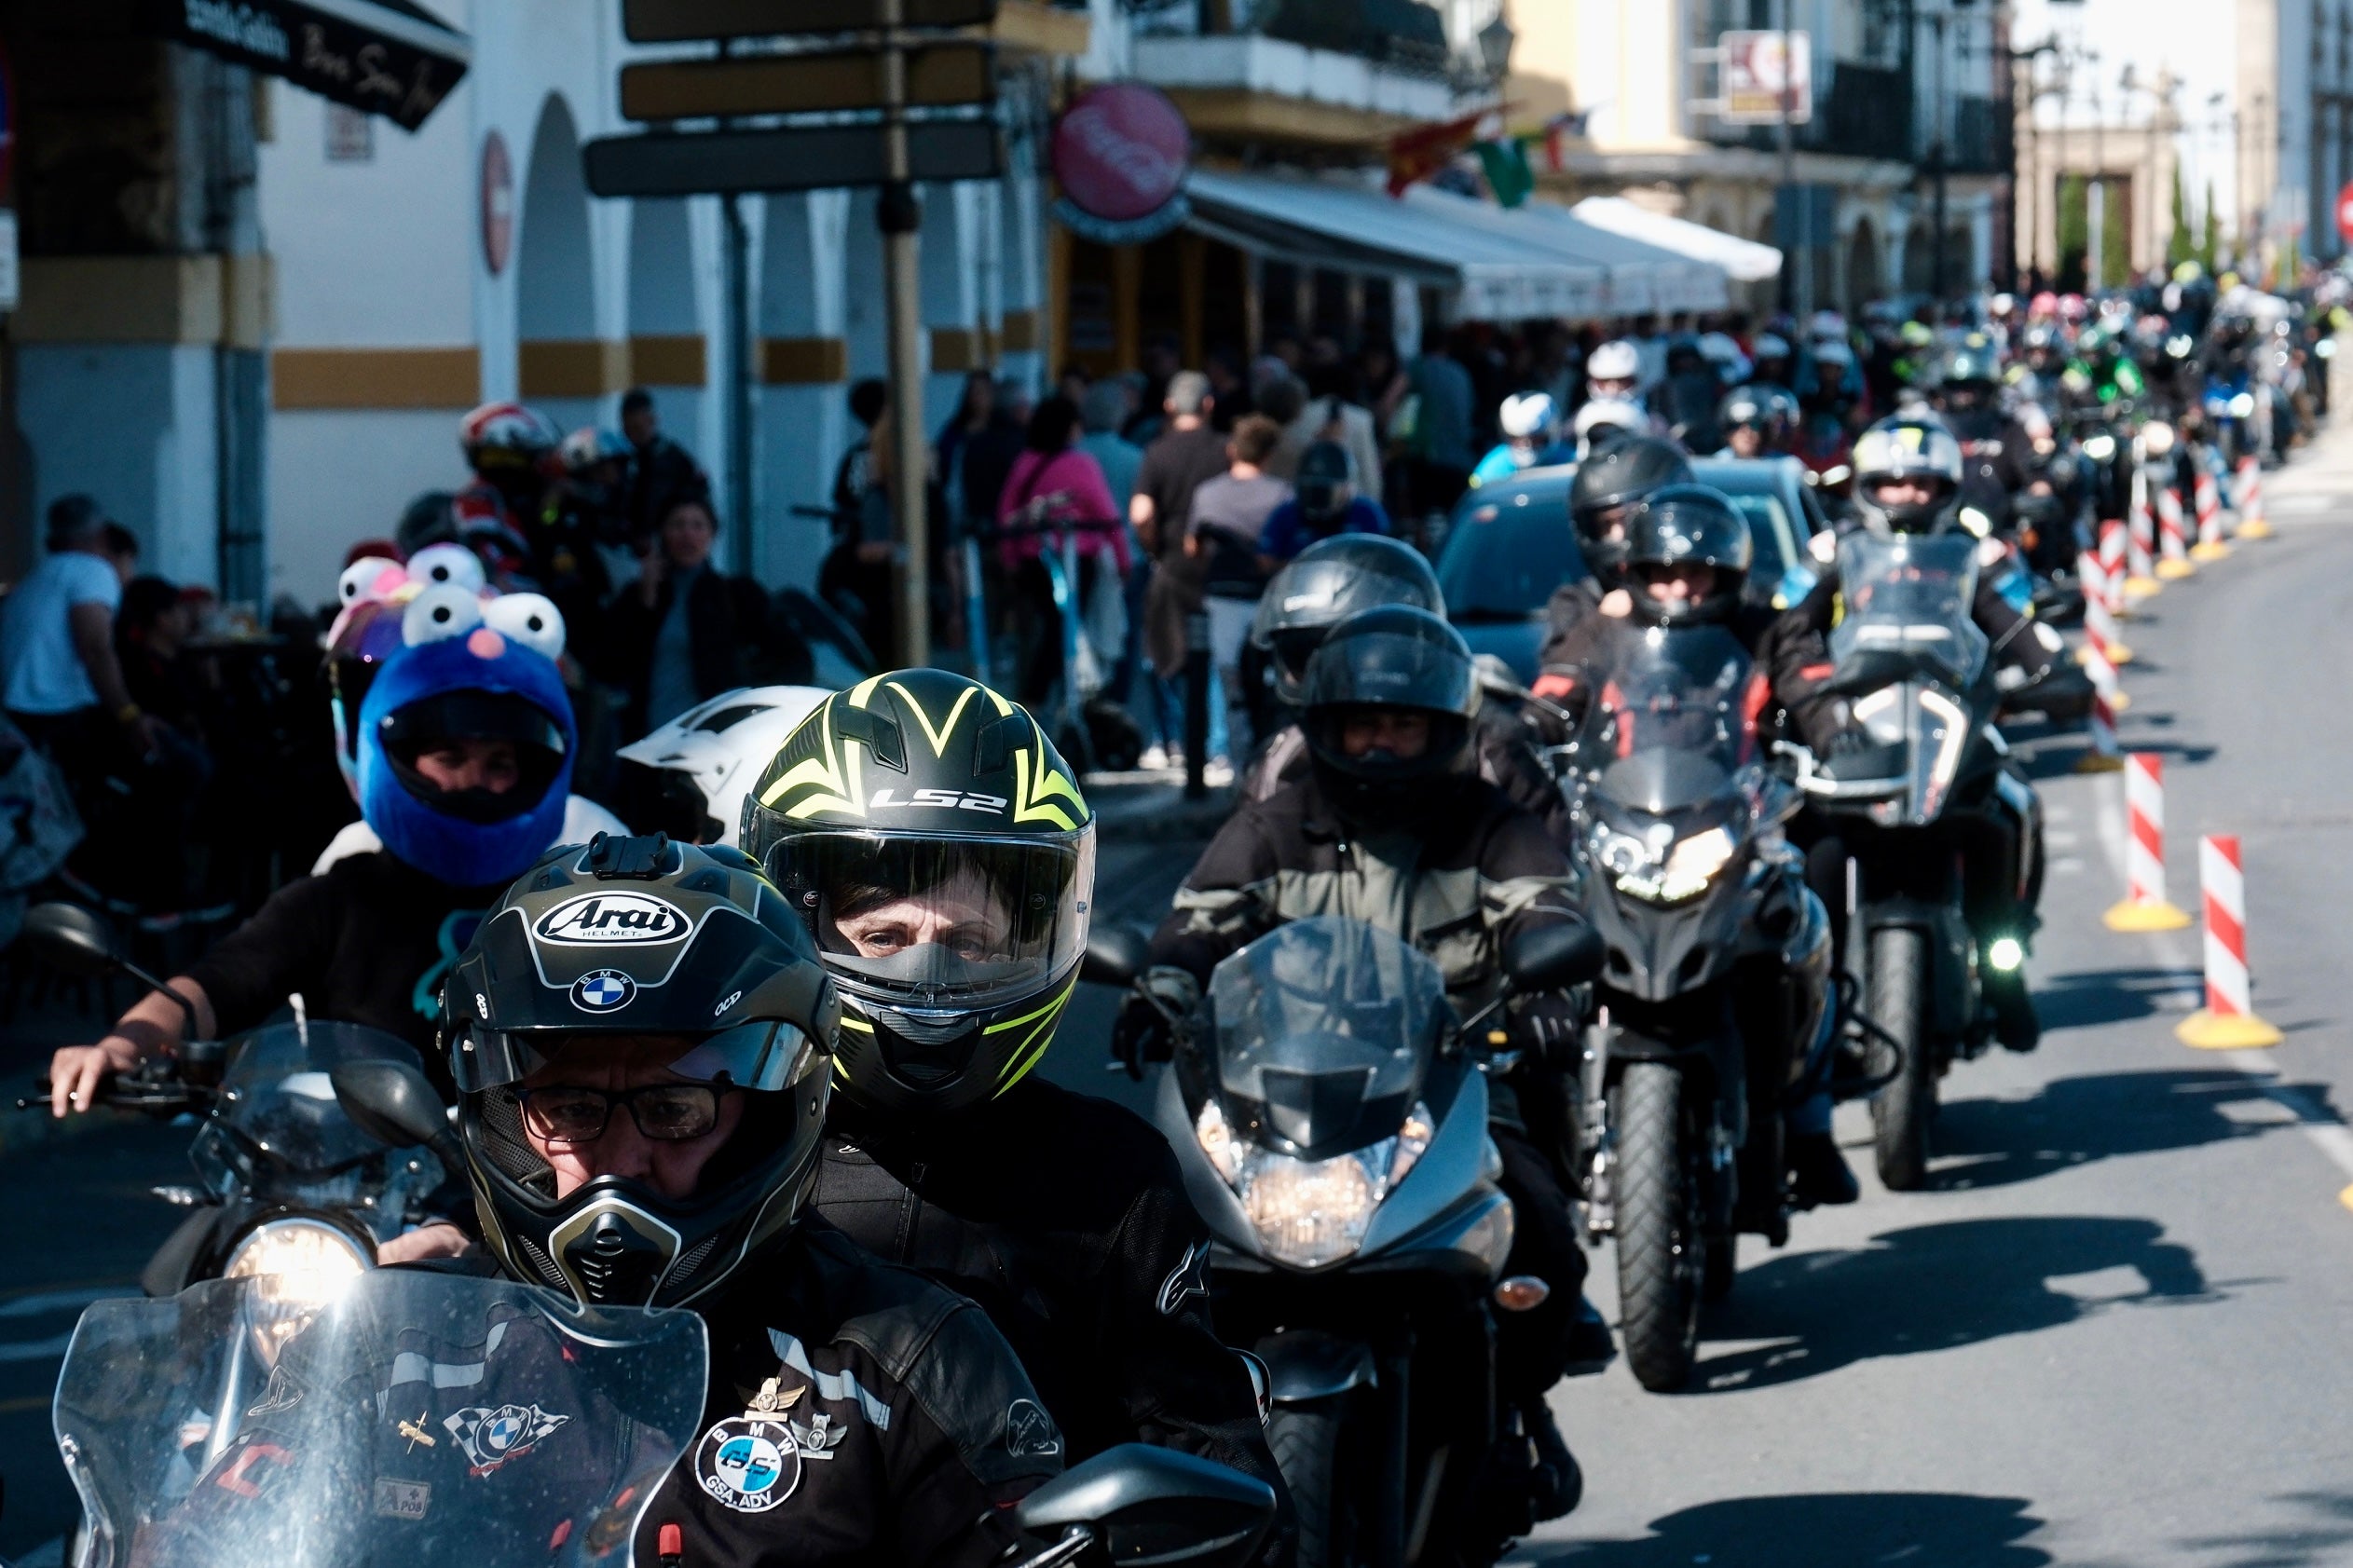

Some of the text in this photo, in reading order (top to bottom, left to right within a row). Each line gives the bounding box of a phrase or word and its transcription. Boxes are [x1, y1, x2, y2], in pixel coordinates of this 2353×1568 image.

[869, 788, 1008, 815] LS2
[545, 899, 671, 935] Arai
[580, 971, 631, 985] BMW
[486, 1407, 528, 1428] BMW
[712, 1421, 795, 1456] BMW
